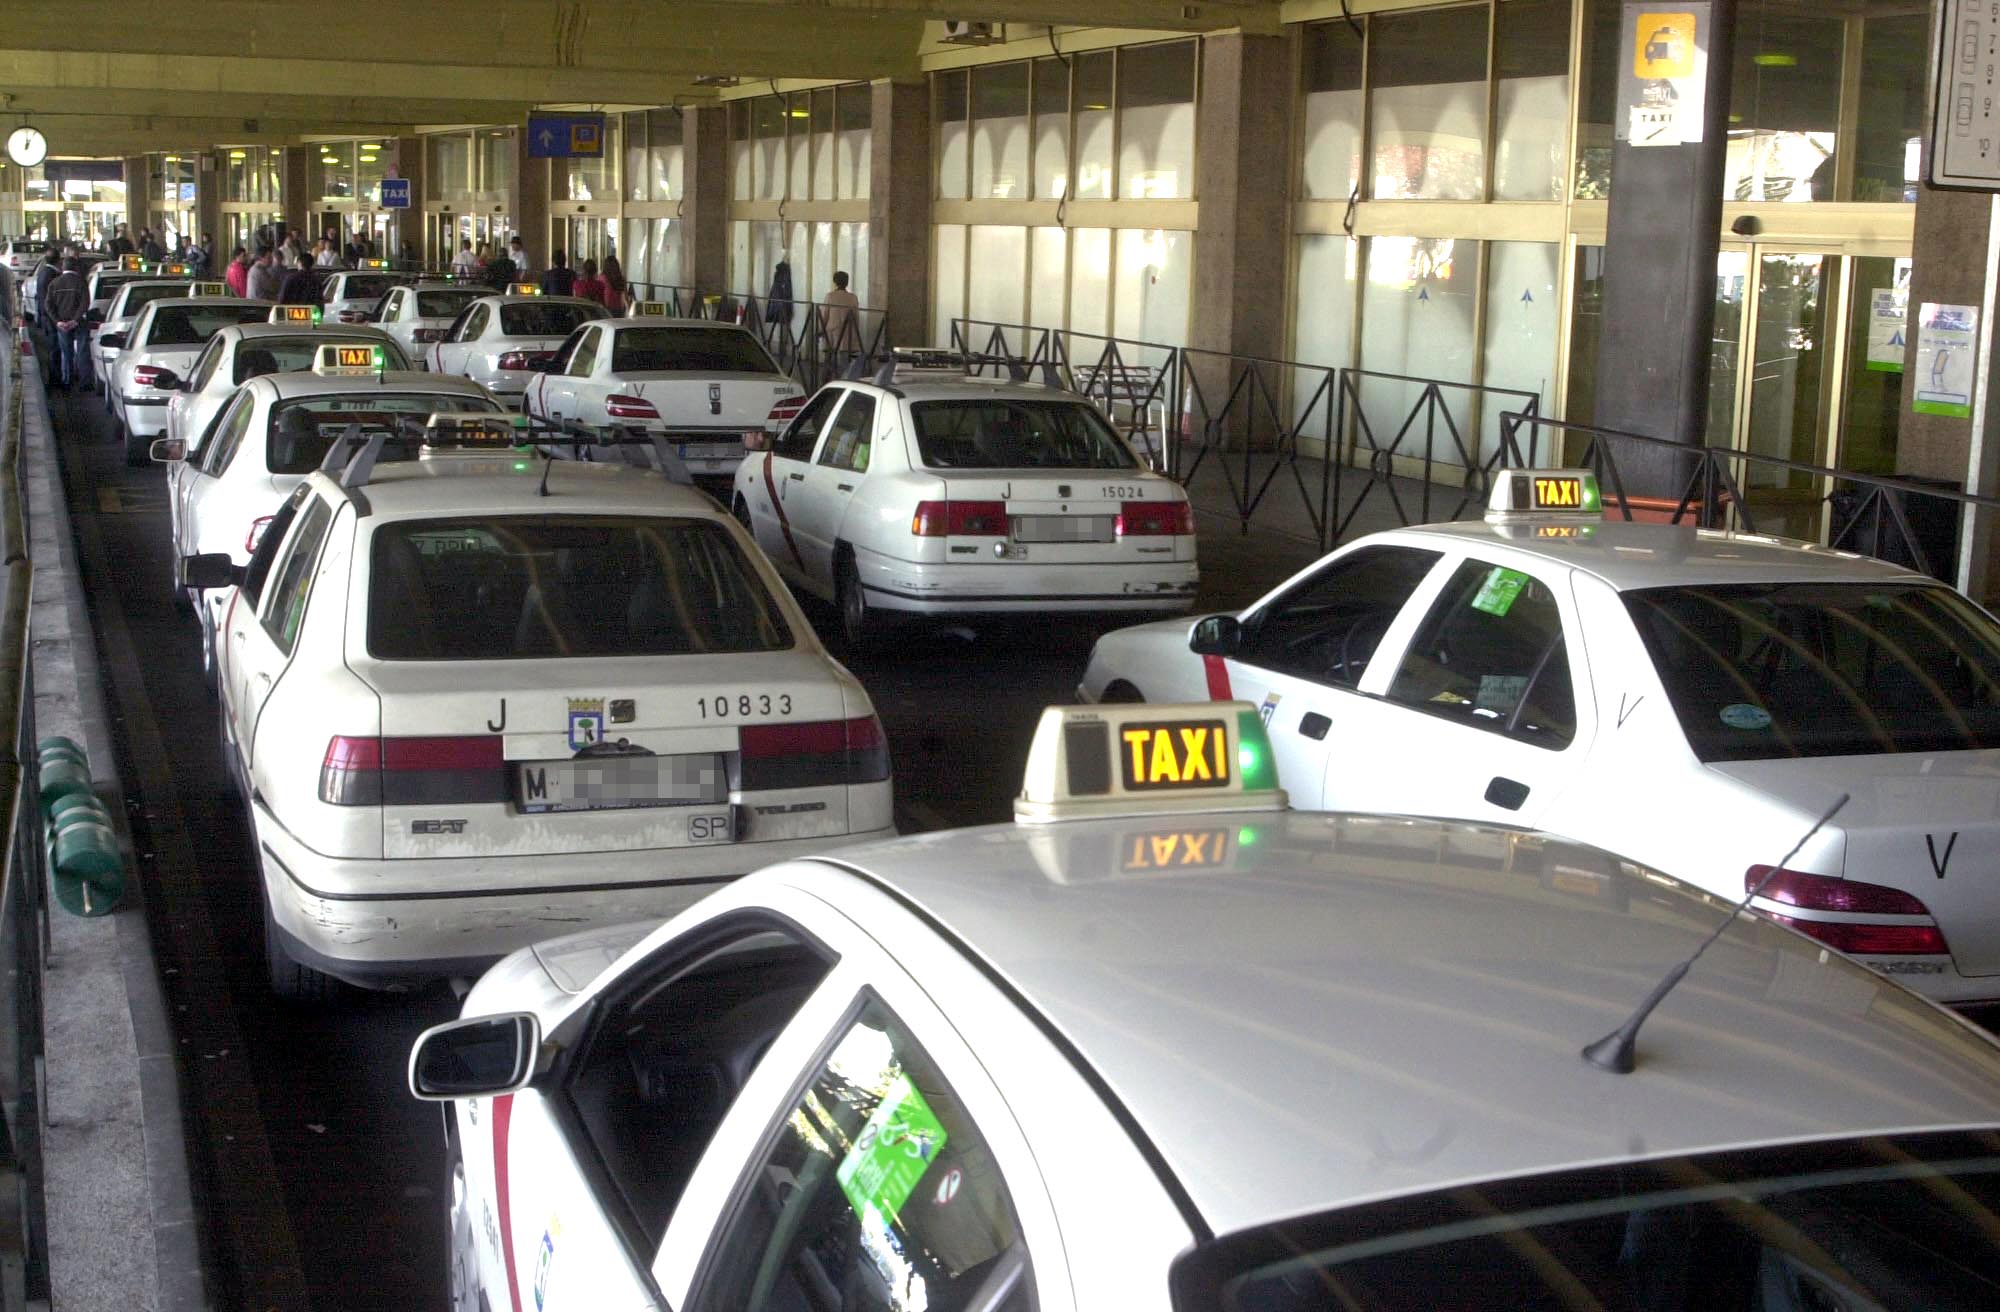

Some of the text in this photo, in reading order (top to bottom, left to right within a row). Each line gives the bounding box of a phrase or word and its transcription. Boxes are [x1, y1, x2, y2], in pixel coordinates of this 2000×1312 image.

[1989, 33, 1997, 46] 7
[1986, 64, 1994, 77] 8
[1984, 97, 1992, 110] 9
[1641, 114, 1672, 123] TAXI
[1978, 138, 1990, 151] 10
[382, 188, 409, 199] TAXI
[288, 308, 311, 320] TAXI
[340, 350, 370, 365] TAXI
[633, 383, 646, 398] V
[1000, 482, 1011, 499] J
[1536, 480, 1579, 505] TAXI
[698, 694, 793, 719] 10833
[1617, 692, 1644, 728] V
[487, 698, 506, 732] J
[1123, 727, 1227, 783] TAXI
[526, 769, 547, 801] M
[691, 817, 727, 839] SP
[1925, 831, 1958, 879] V
